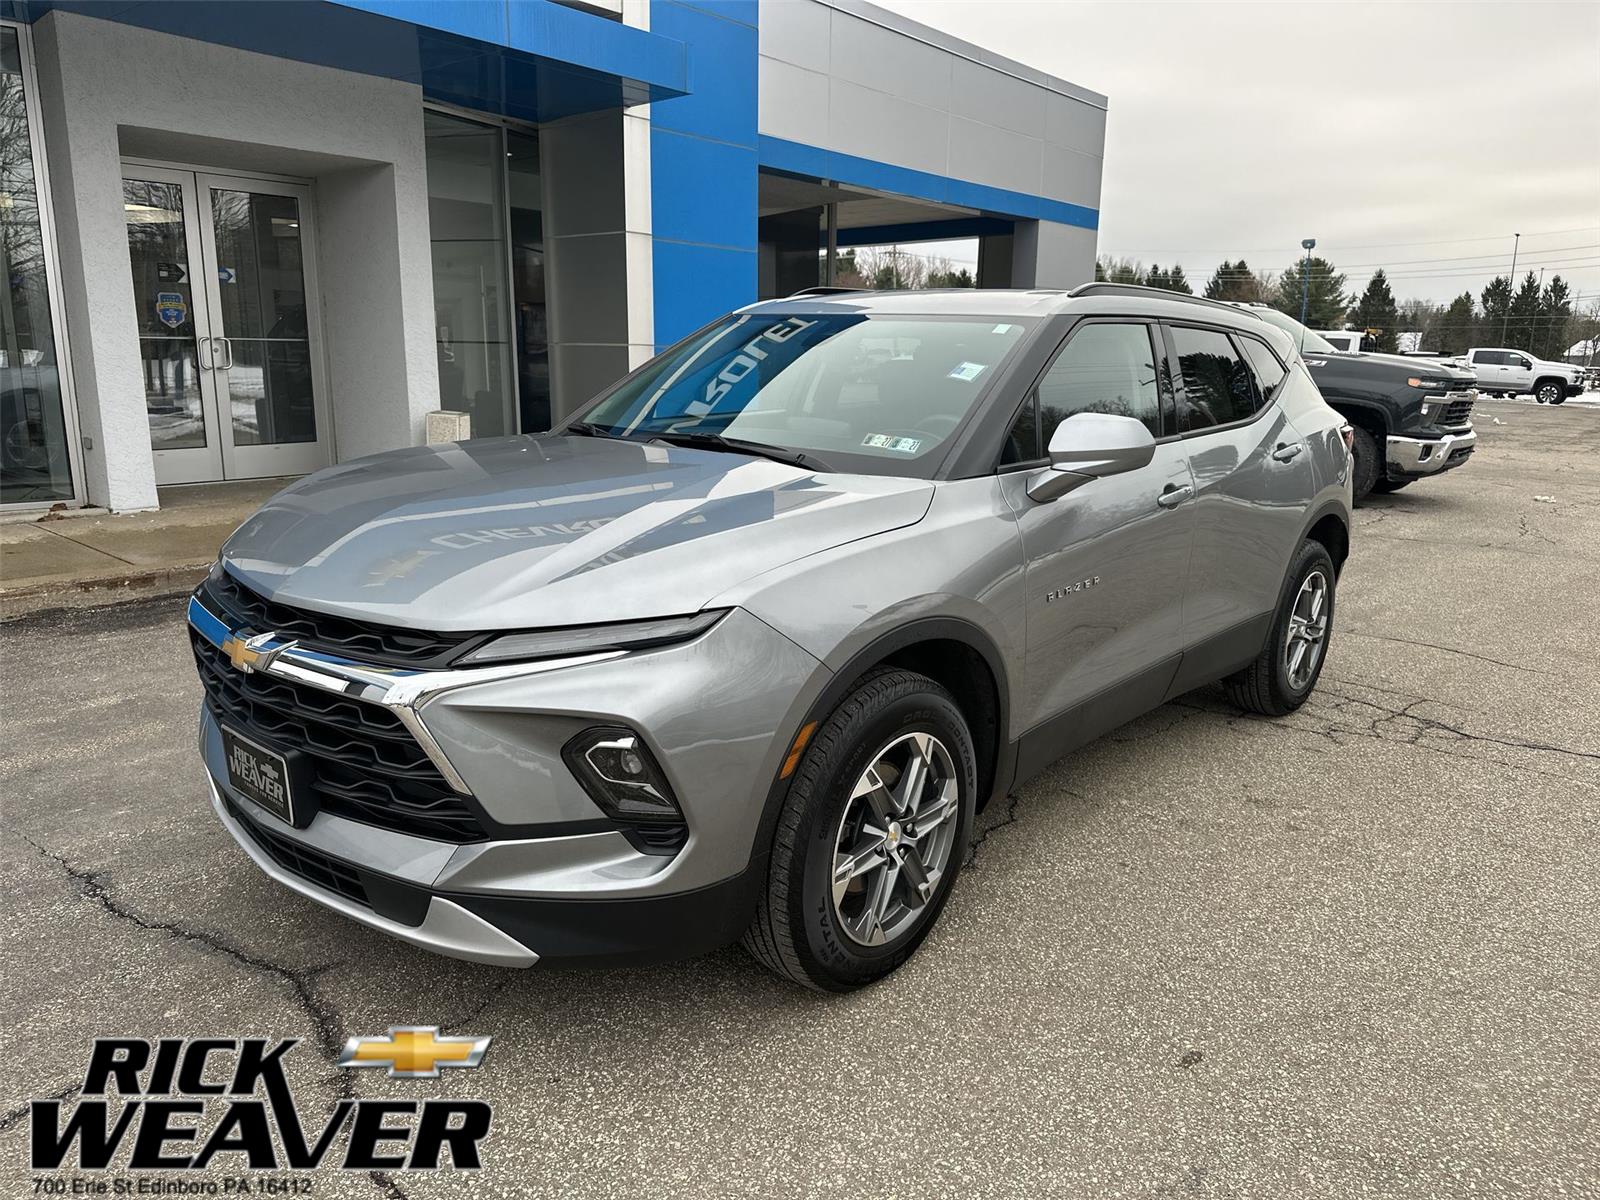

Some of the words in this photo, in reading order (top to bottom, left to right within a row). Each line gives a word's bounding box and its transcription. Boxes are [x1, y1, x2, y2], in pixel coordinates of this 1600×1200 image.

[1046, 575, 1100, 603] BLAZER
[233, 744, 258, 771] RICK
[229, 755, 284, 803] WEAVER
